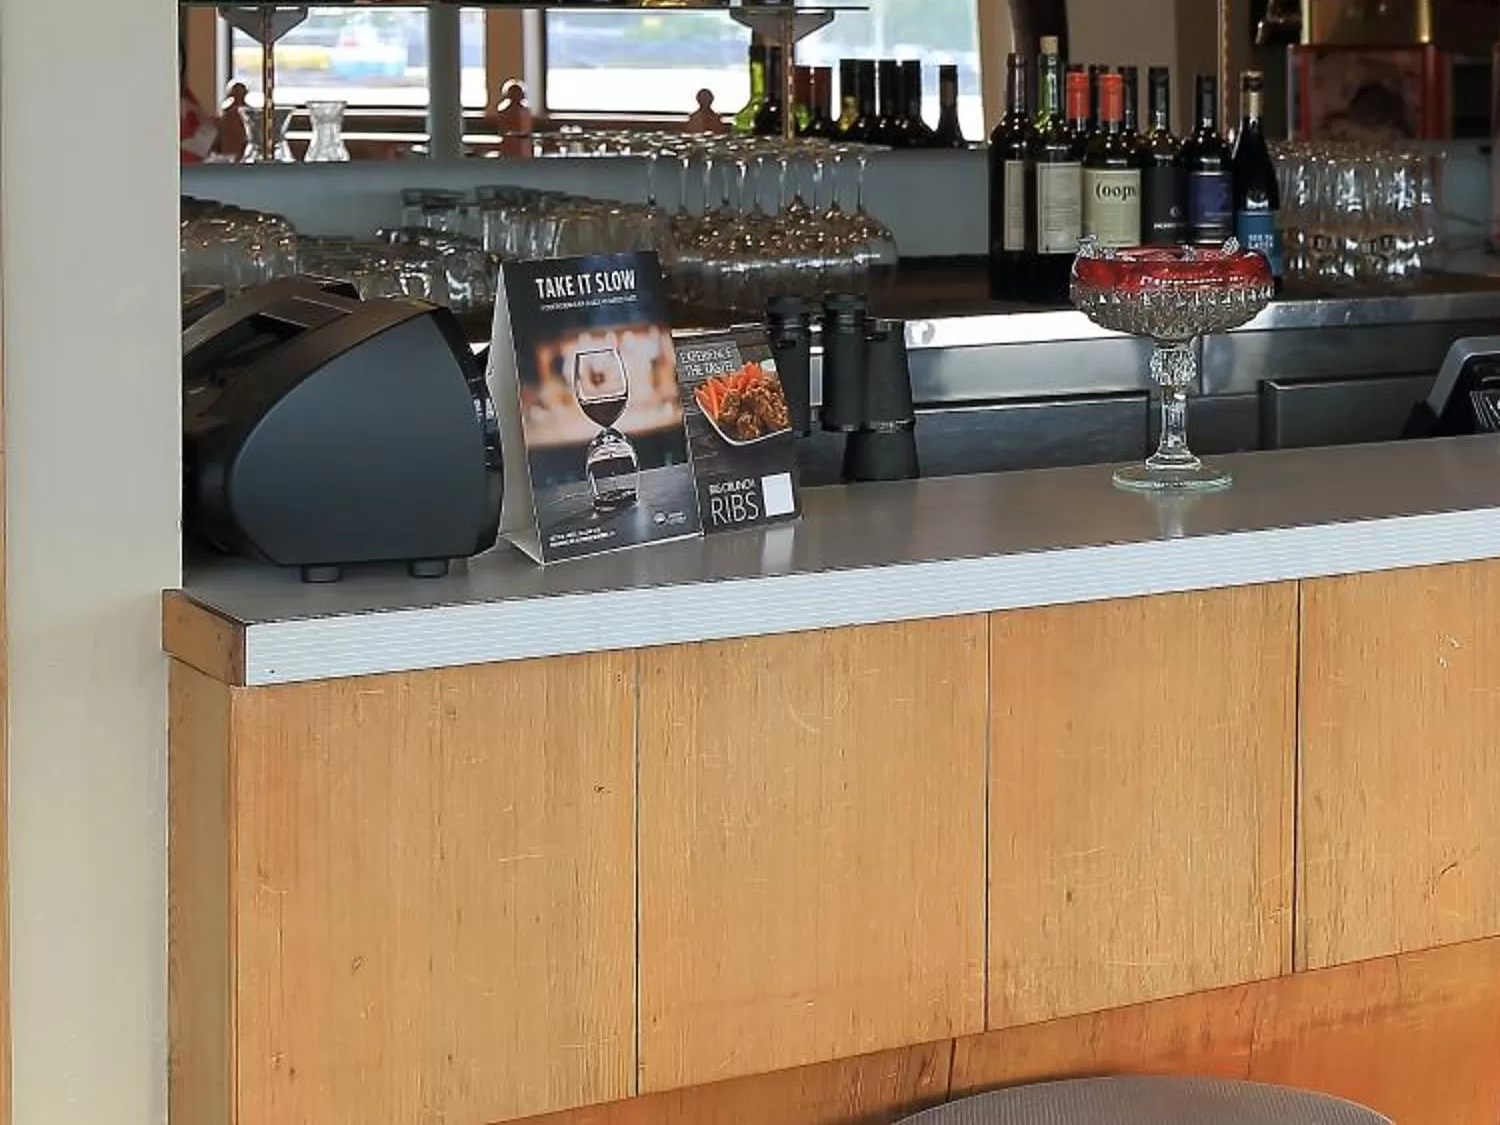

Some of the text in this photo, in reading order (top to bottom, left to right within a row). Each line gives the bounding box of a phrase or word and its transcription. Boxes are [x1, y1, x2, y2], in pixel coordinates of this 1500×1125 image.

[535, 269, 636, 299] TAKE IT SLOW
[710, 491, 760, 526] RIBS
